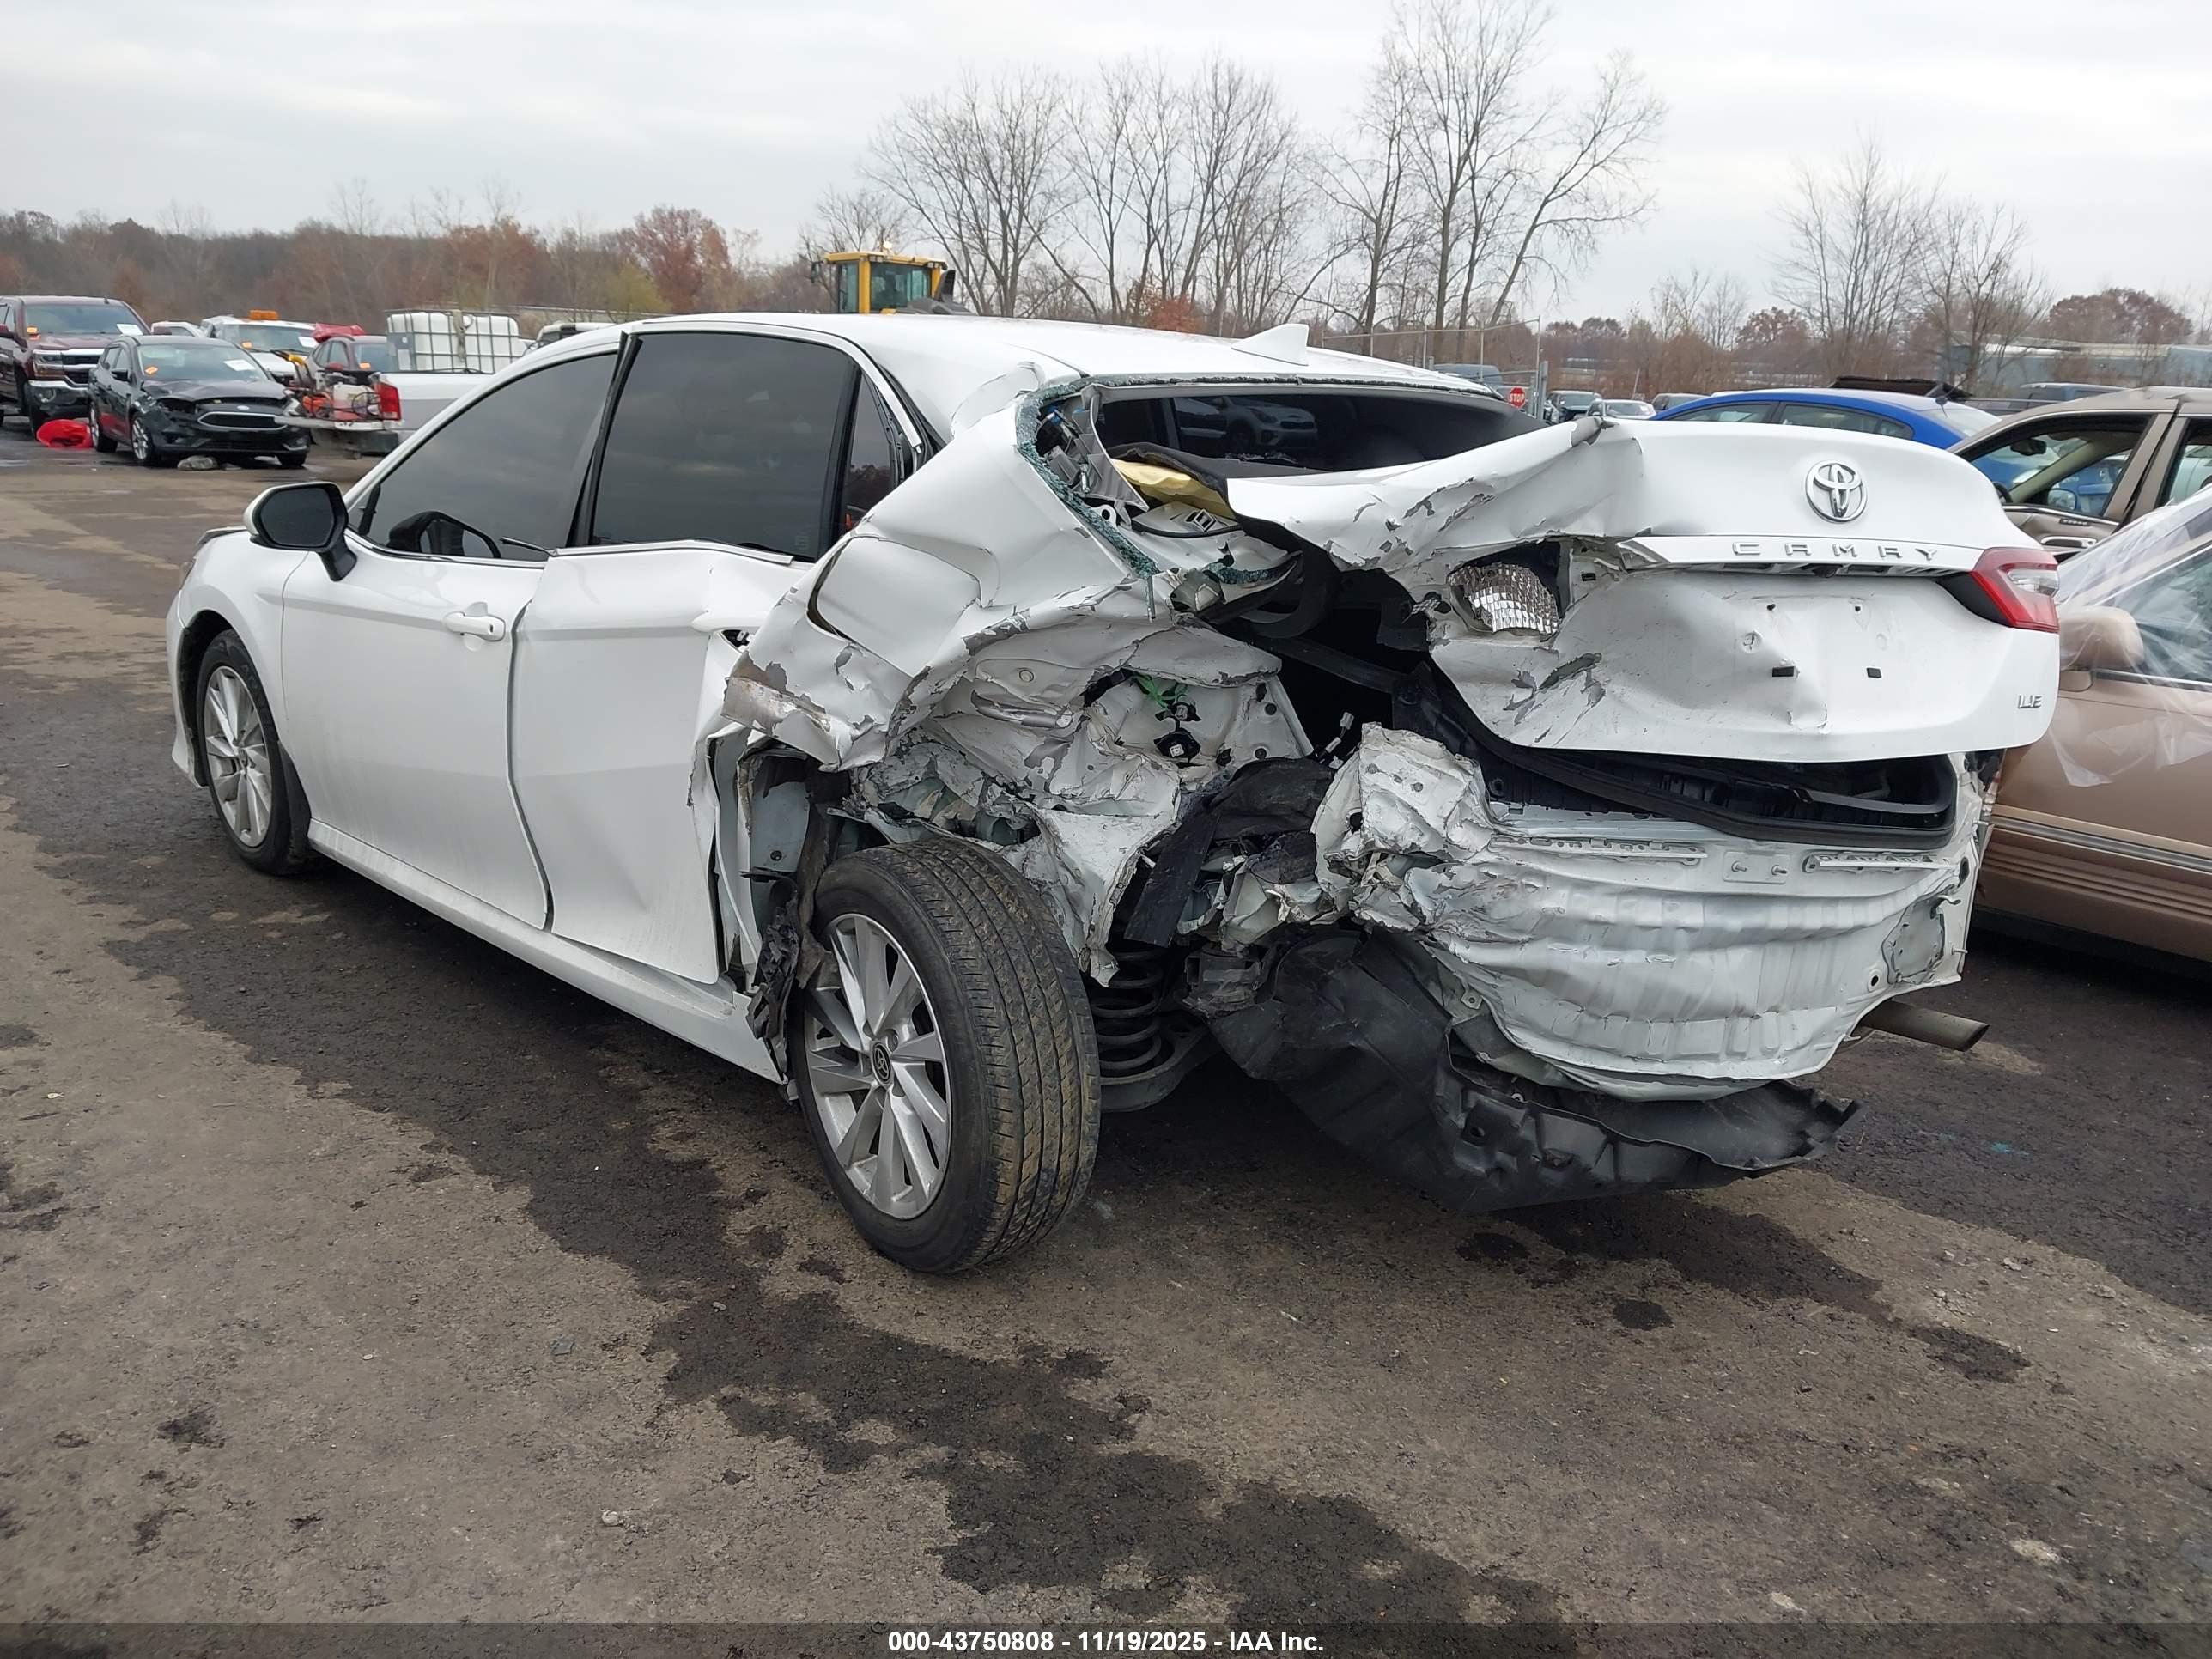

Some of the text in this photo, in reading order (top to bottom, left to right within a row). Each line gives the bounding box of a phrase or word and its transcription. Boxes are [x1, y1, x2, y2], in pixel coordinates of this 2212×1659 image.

[1510, 393, 1525, 403] STOP
[1732, 542, 1937, 561] CAMRY
[2017, 694, 2042, 709] LE
